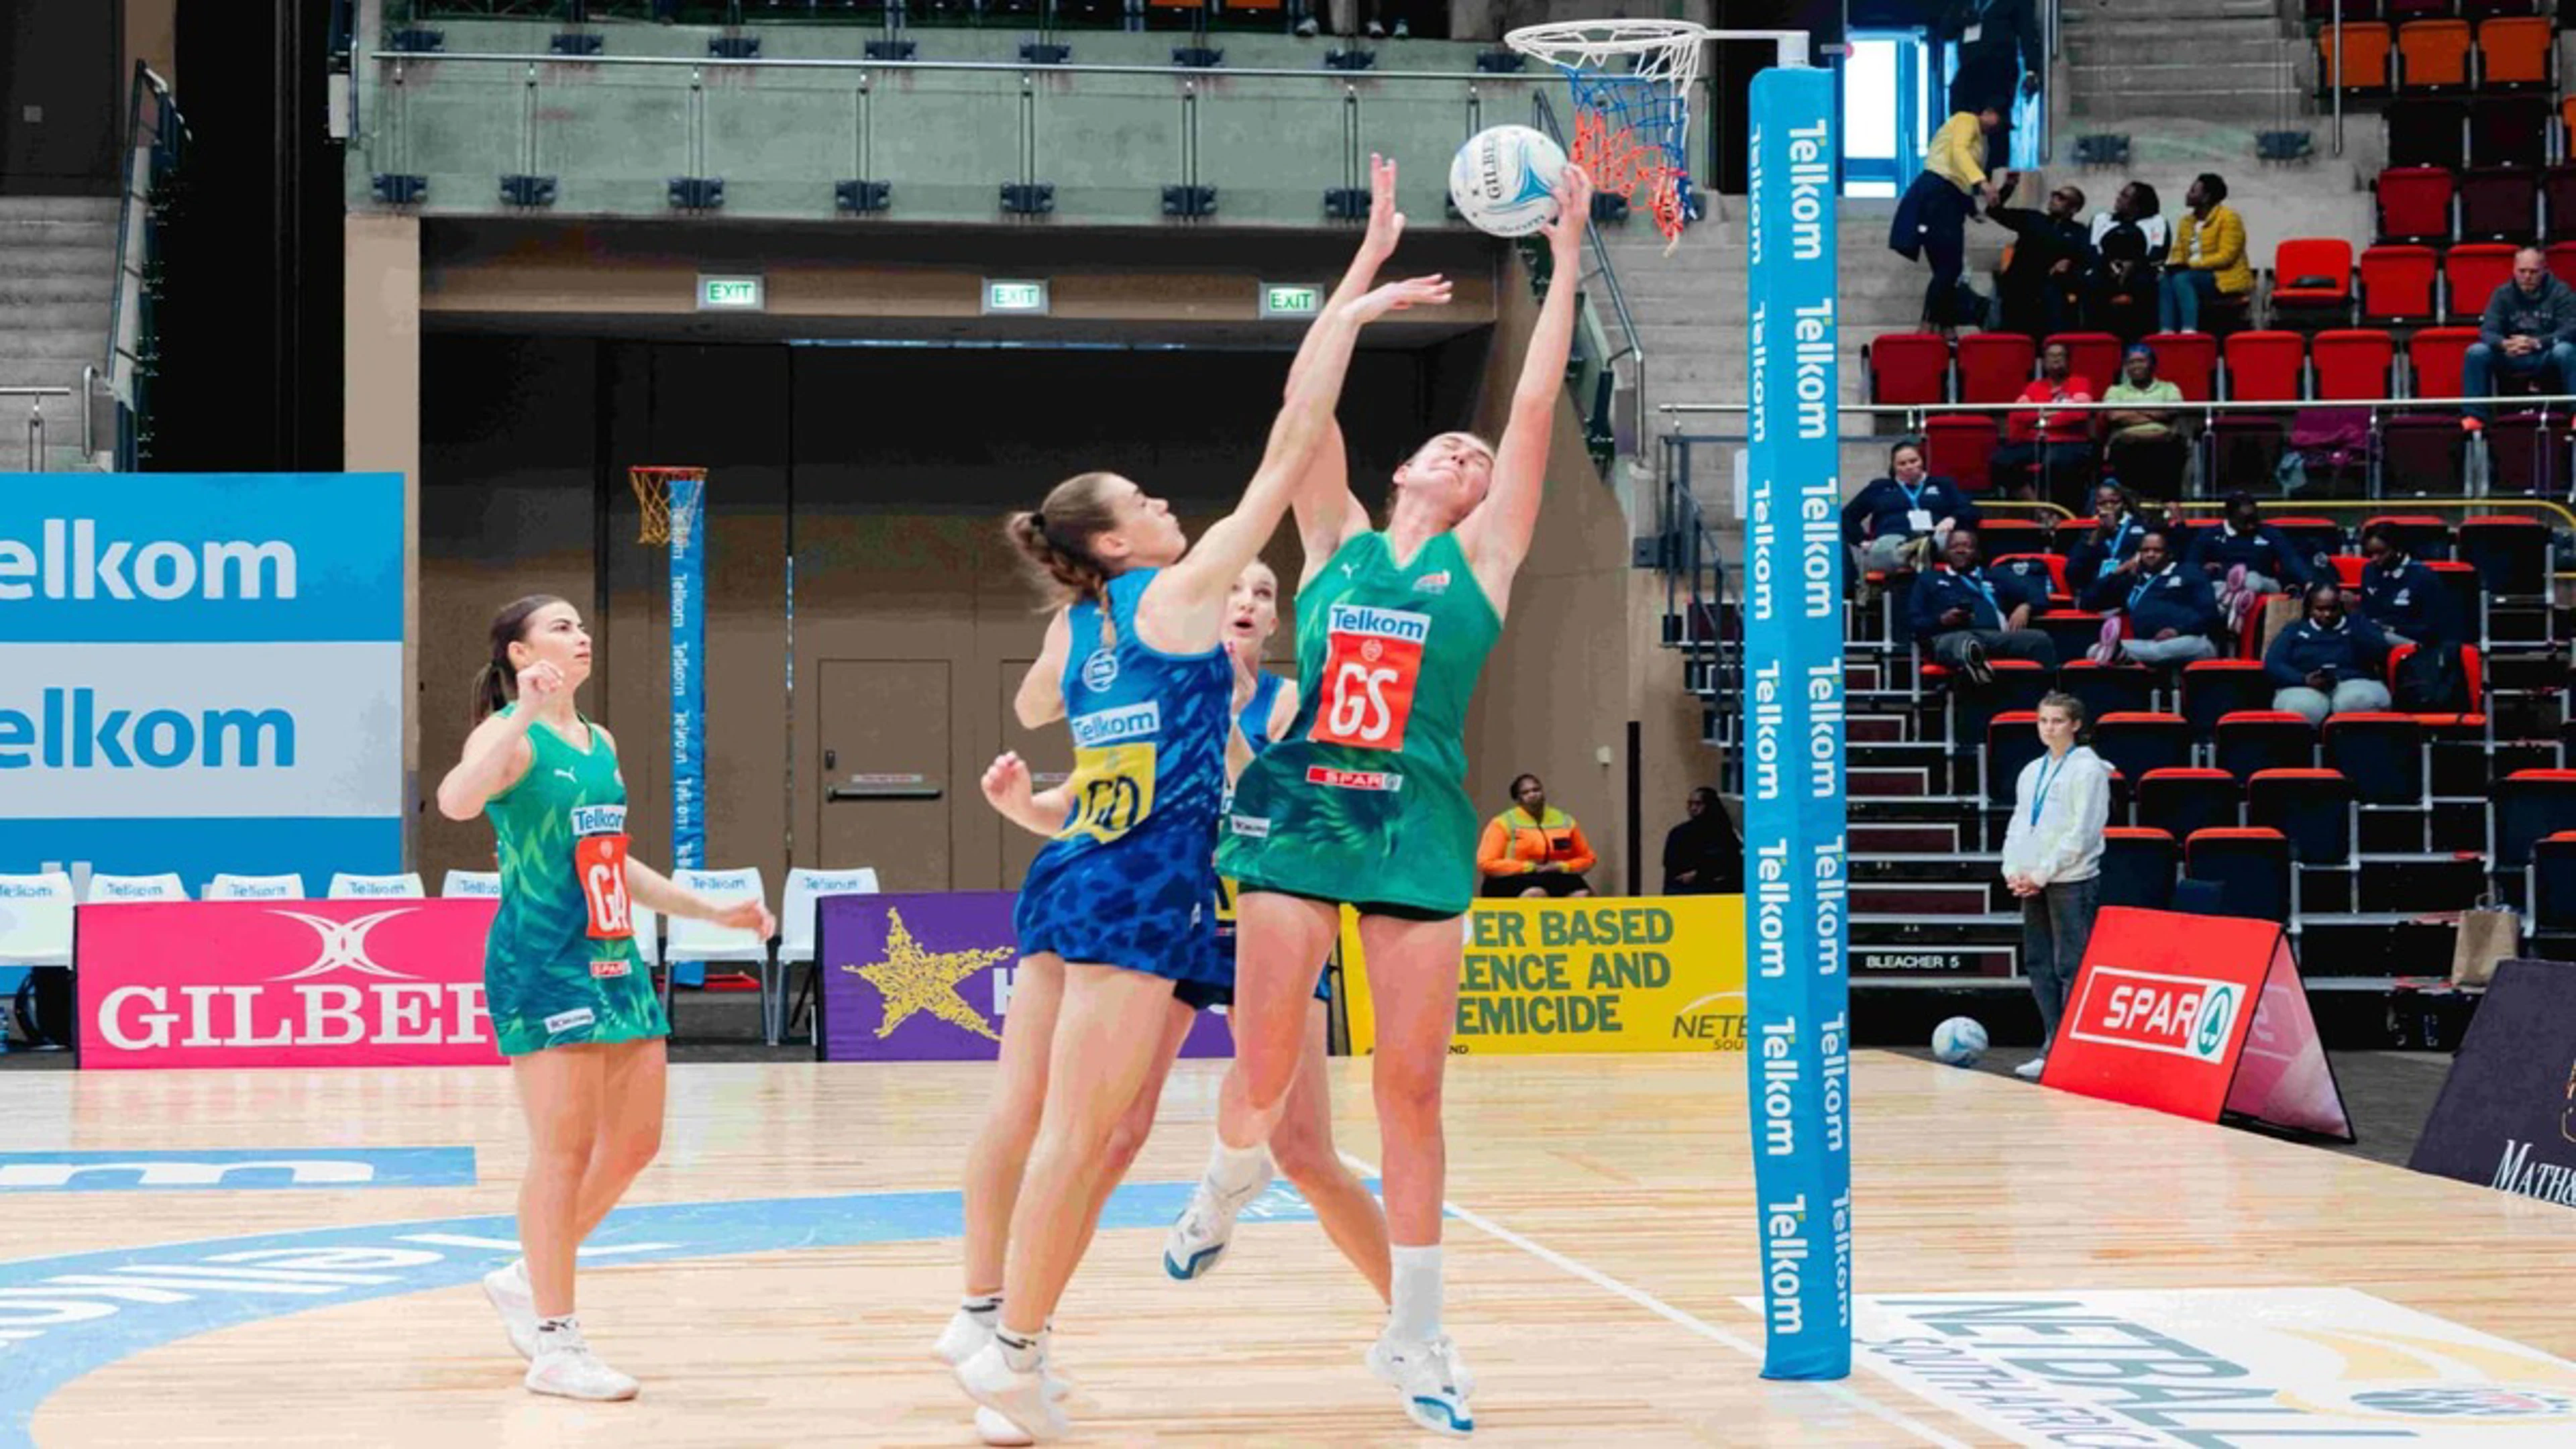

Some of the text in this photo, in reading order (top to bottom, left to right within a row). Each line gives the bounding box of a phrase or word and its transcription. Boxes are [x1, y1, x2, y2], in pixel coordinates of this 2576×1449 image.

[1751, 123, 1761, 264] Telkom
[1788, 119, 1829, 260] Telkom
[710, 283, 752, 301] EXIT
[995, 287, 1036, 304] EXIT
[1271, 292, 1311, 309] EXIT
[1752, 302, 1767, 442] Telkom
[1795, 298, 1833, 439] Telkom
[1754, 480, 1774, 620] Telkom
[1801, 477, 1837, 618] Telkom
[1333, 608, 1424, 639] Telkom
[1073, 711, 1155, 737] Telkom
[1328, 661, 1399, 741] GS
[1756, 659, 1782, 799] Telkom
[1809, 657, 1842, 797] Telkom
[1325, 772, 1382, 788] SPAR
[588, 863, 630, 932] GA
[1539, 908, 1674, 947] BASED
[1758, 838, 1790, 977] Telkom
[1815, 835, 1845, 975] Telkom
[1865, 955, 1944, 968] BLEACHER
[1460, 952, 1671, 991] ENCE AND
[2103, 985, 2202, 1037] SPAR
[1762, 1016, 1799, 1156] Telkom
[1821, 1012, 1845, 1152] Telkom
[1768, 1194, 1808, 1335] Telkom
[1833, 1188, 1851, 1328] Telkom
[1875, 1300, 2420, 1449] NETBALL
